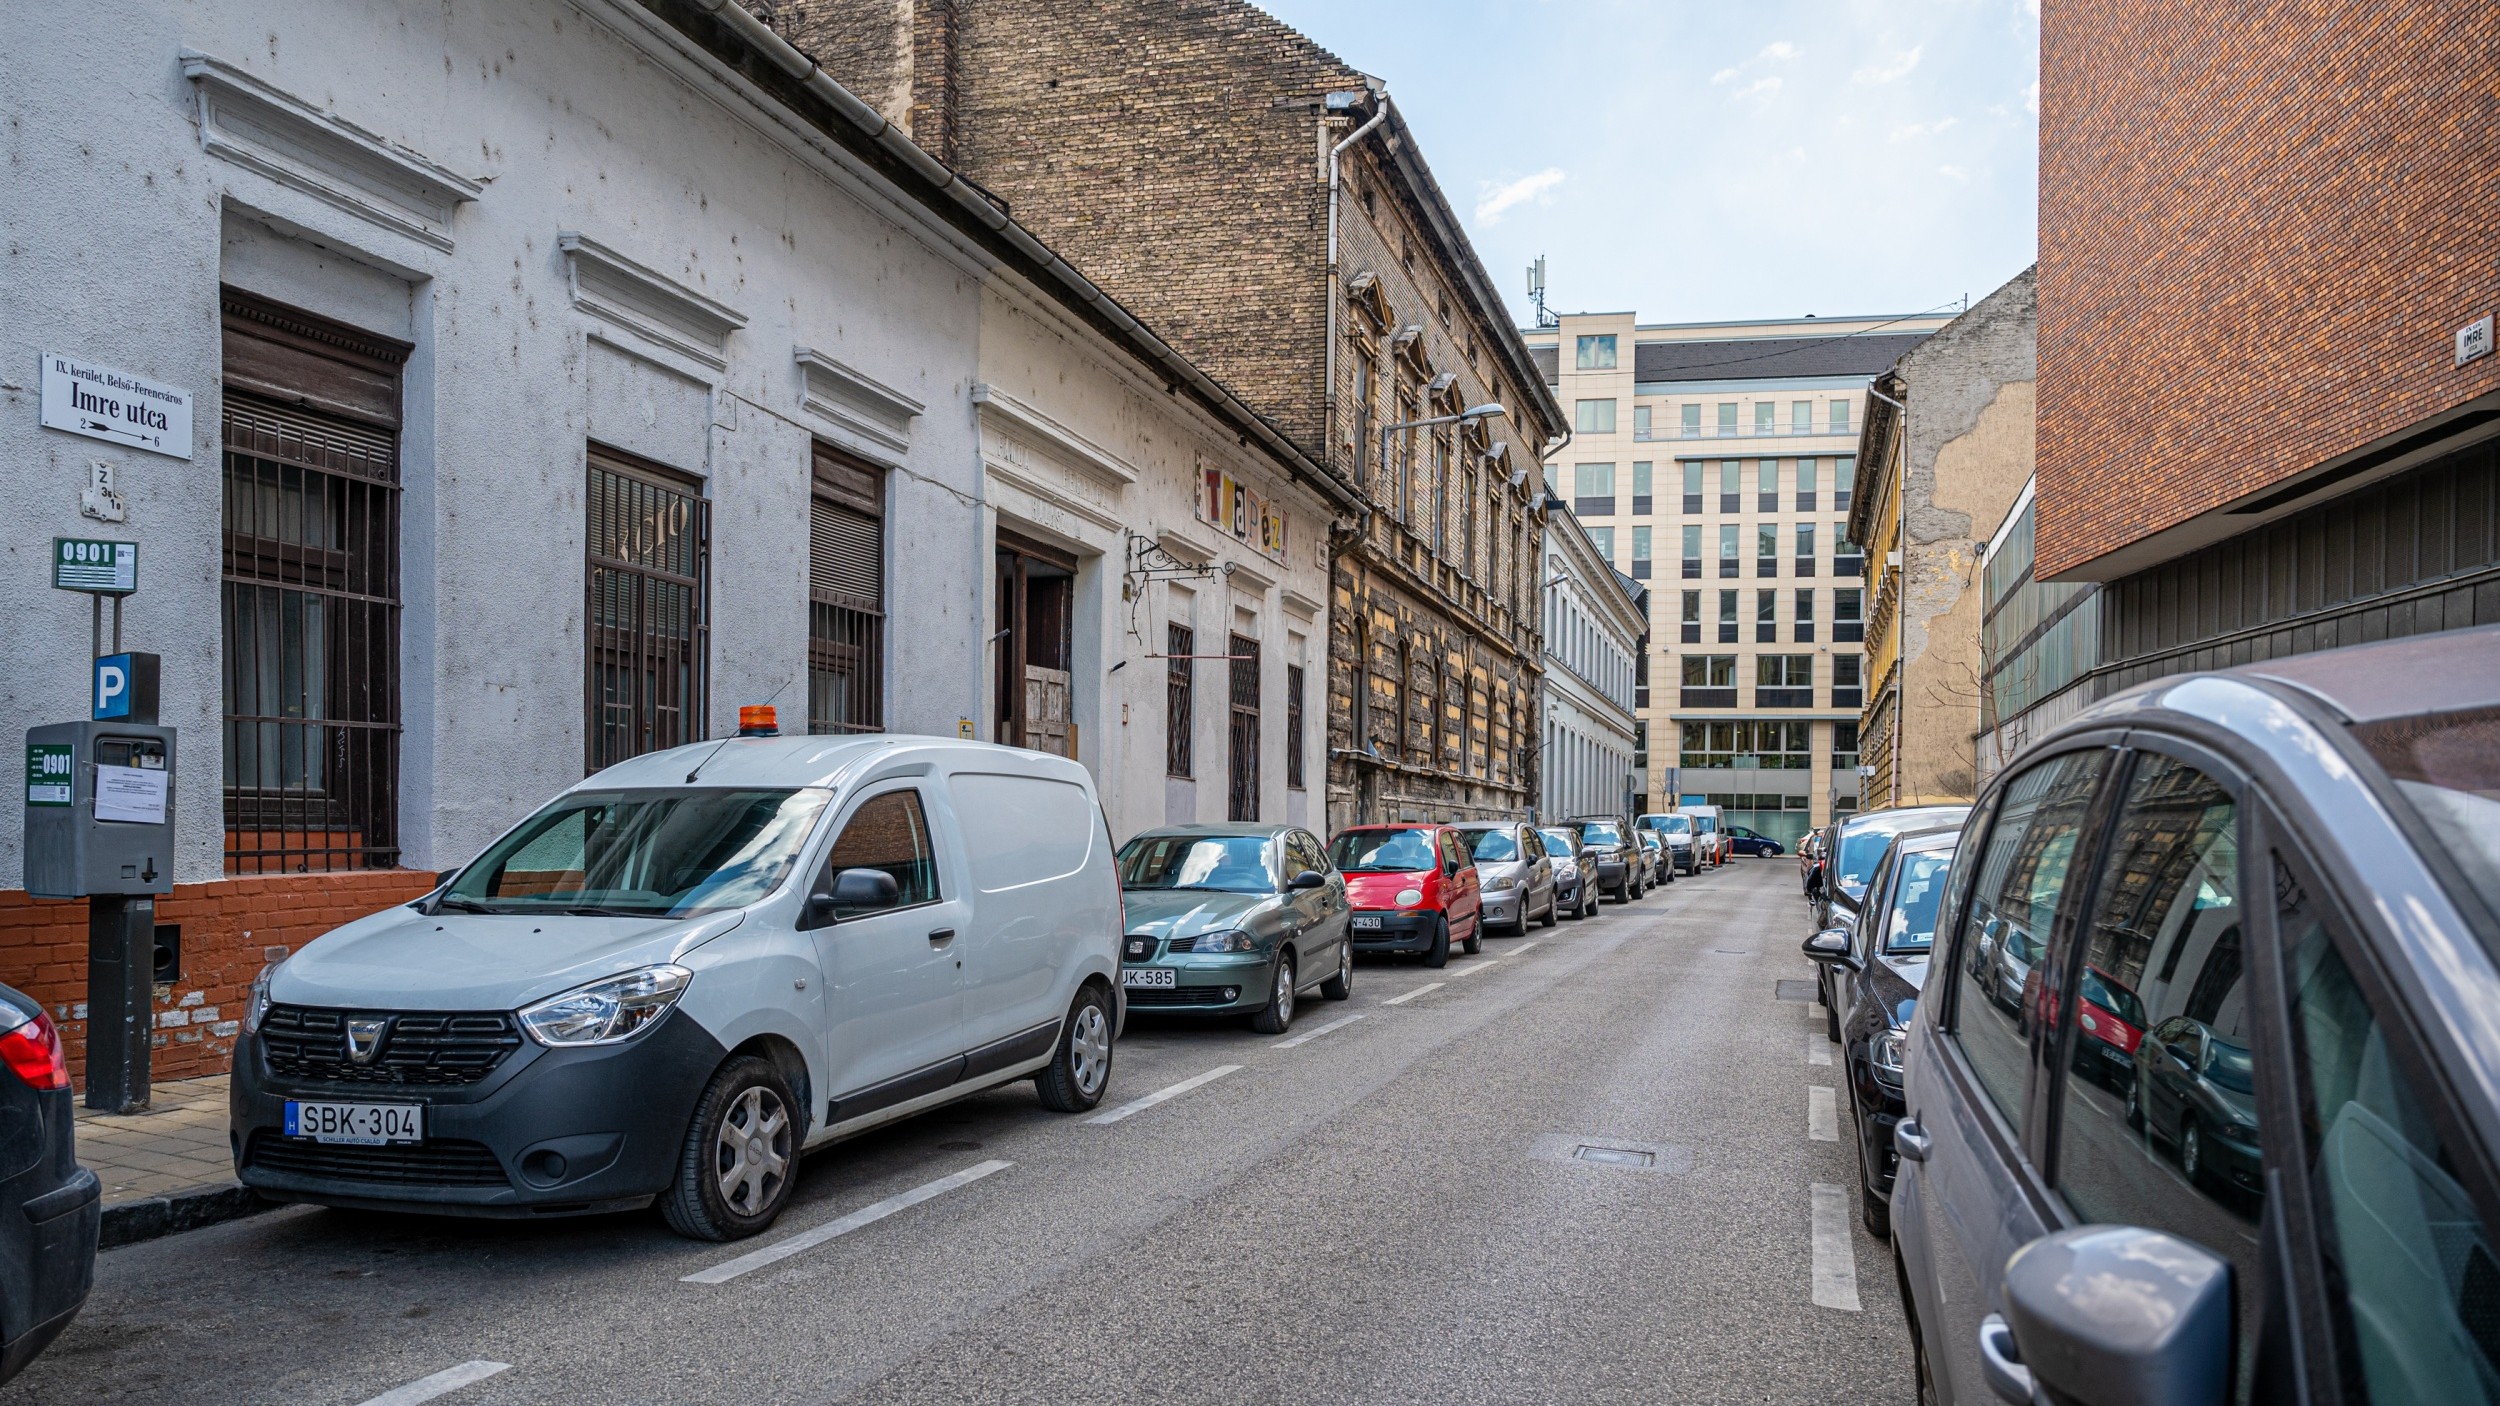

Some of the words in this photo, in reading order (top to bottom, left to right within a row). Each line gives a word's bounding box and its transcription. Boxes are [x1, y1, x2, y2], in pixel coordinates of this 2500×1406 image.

[2464, 328, 2482, 347] IMRE
[56, 360, 68, 374] IX.
[71, 364, 105, 386] kerület,
[107, 374, 183, 405] Belső-Ferencváros
[71, 381, 120, 418] Imre
[126, 401, 168, 431] utca
[80, 417, 86, 429] 2
[154, 437, 160, 447] 6
[99, 471, 108, 483] Z
[63, 541, 110, 562] 0901
[99, 666, 125, 708] P
[43, 754, 70, 774] 0901
[288, 1121, 296, 1131] H
[304, 1106, 415, 1136] SBK-304
[346, 1136, 360, 1144] AUTÓ
